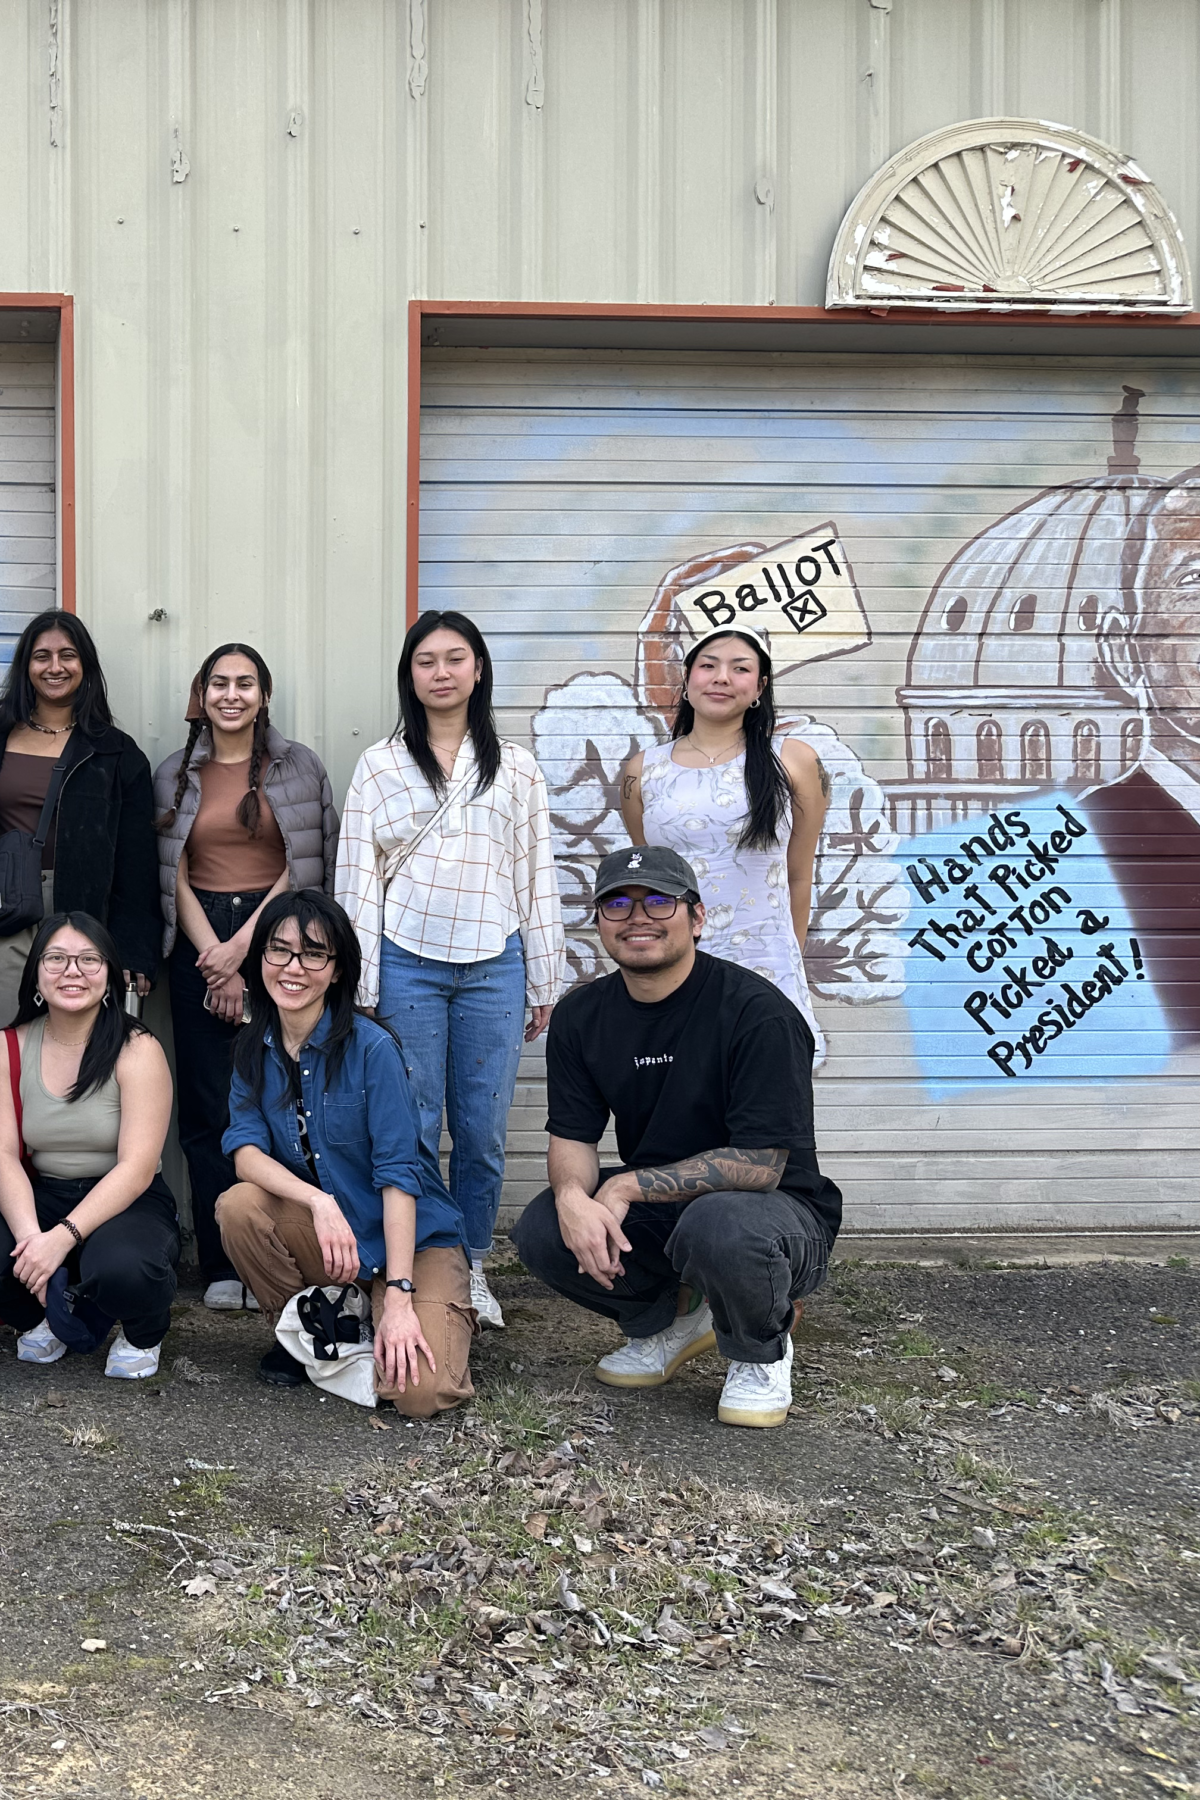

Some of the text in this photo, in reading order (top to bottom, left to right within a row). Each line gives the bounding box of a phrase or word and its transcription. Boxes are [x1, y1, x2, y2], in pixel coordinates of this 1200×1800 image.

[906, 811, 1031, 904] Hands
[988, 803, 1088, 903] Picked
[963, 909, 1110, 1036] Picked a
